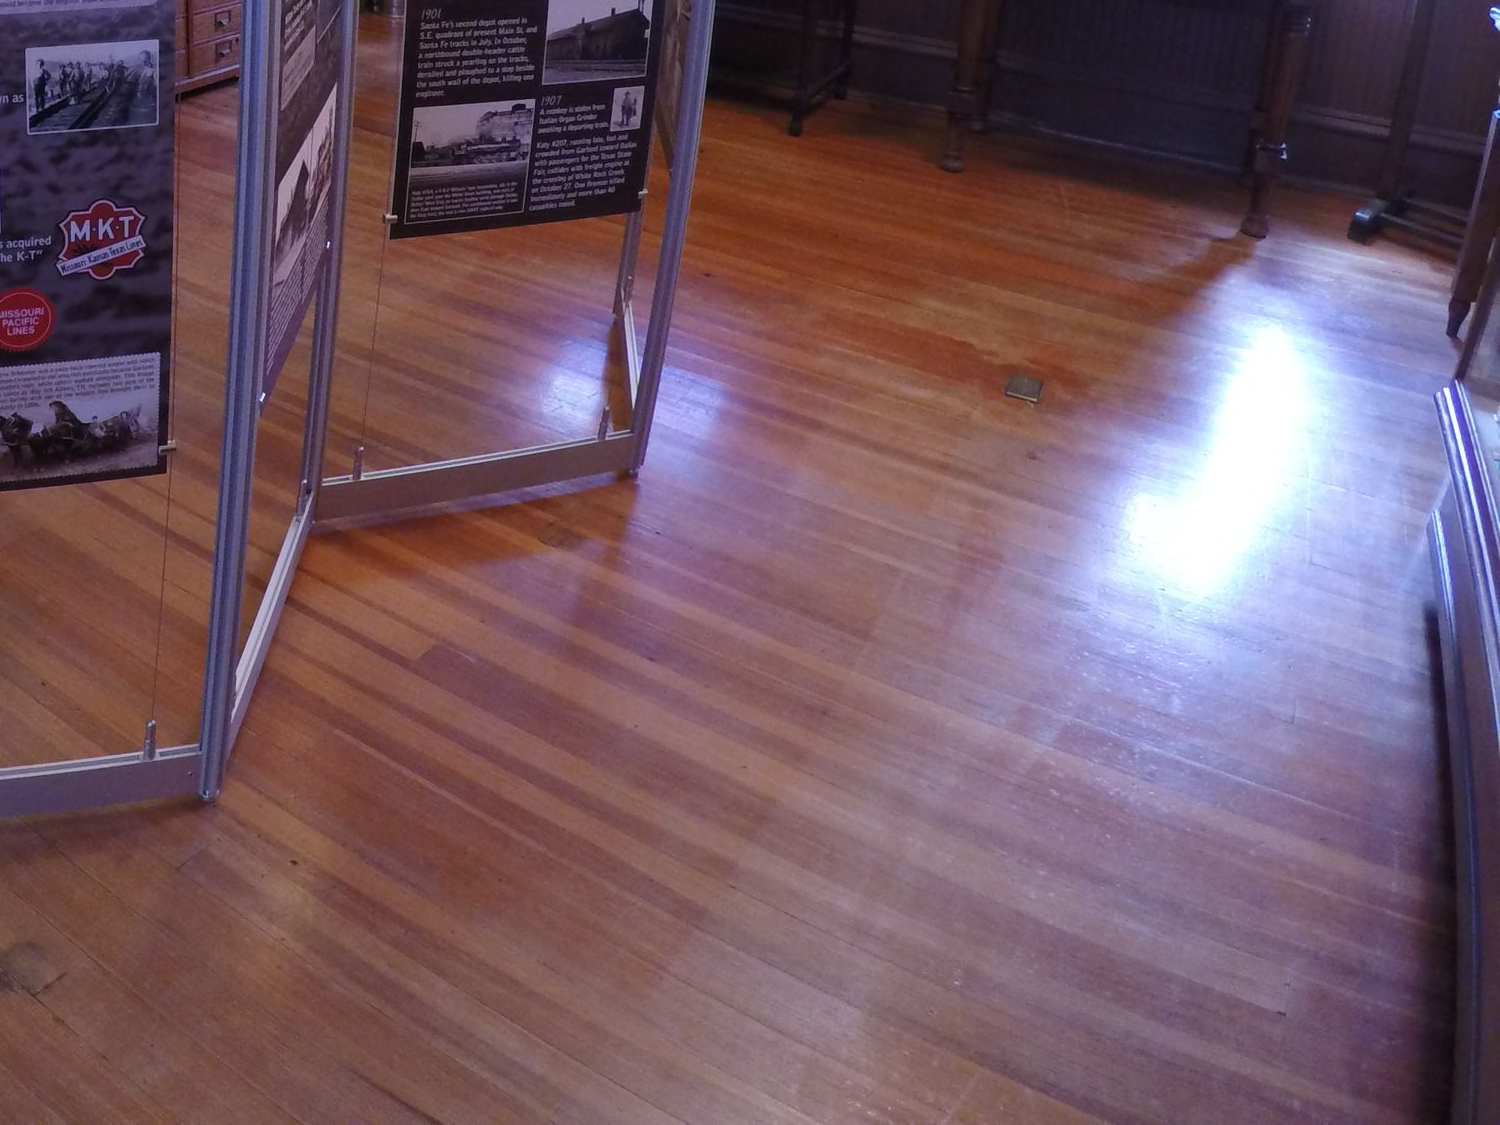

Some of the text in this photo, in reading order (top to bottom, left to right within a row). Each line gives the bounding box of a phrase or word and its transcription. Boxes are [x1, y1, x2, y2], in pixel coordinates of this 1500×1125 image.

[421, 8, 442, 20] 1901
[12, 94, 25, 103] as
[541, 95, 562, 107] 1907
[1, 316, 40, 328] PACIFIC
[7, 325, 36, 337] LINES
